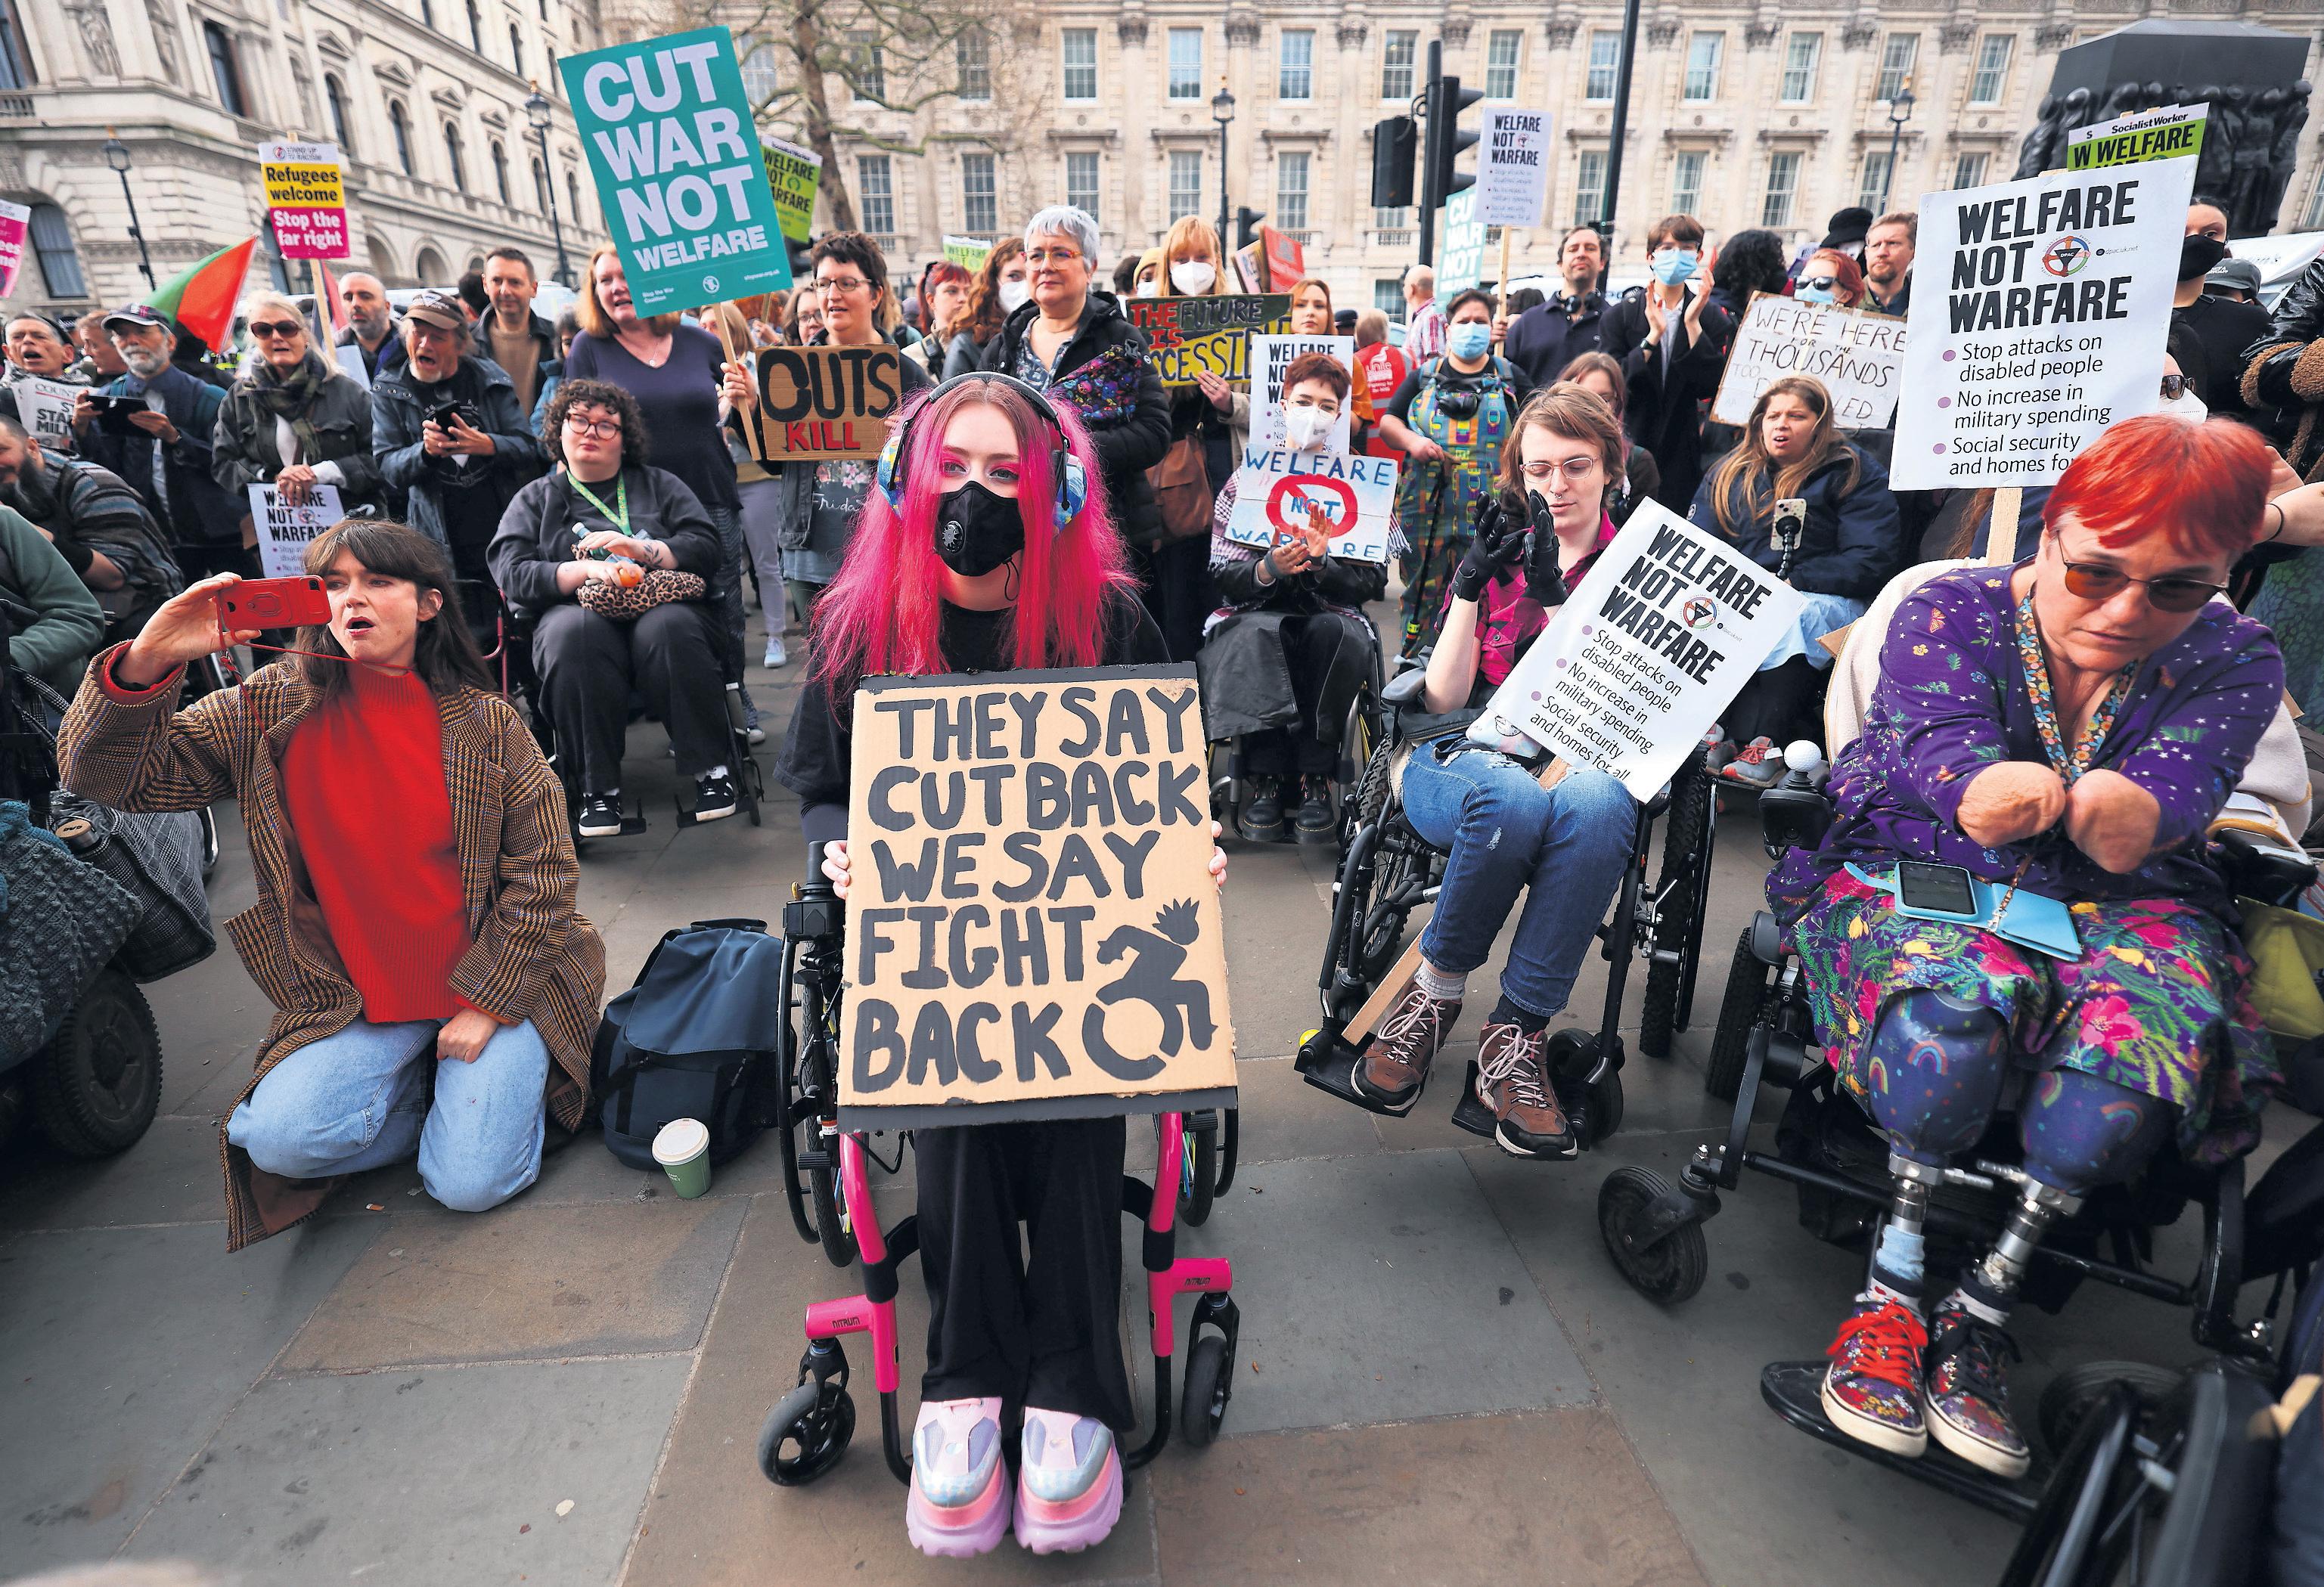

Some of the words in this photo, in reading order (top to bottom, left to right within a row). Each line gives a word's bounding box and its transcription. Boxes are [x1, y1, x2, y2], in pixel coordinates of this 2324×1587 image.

[583, 41, 718, 122] CUT
[1493, 132, 1516, 147] NOT
[1495, 115, 1541, 132] WELFARE
[2111, 119, 2152, 134] Socialist
[2154, 113, 2188, 126] Worker
[593, 107, 749, 182] WAR
[1491, 149, 1538, 166] WARFARE
[2098, 124, 2195, 163] WELFARE
[266, 167, 338, 186] Refugees
[764, 147, 814, 181] WELFARE
[270, 186, 337, 201] welcome
[616, 164, 754, 243] NOT
[771, 186, 811, 213] ARFARE
[1448, 194, 1475, 225] CU
[274, 210, 310, 231] Stop
[312, 211, 341, 228] the
[1958, 181, 2139, 246] WELFARE
[277, 229, 301, 246] far
[303, 230, 343, 250] right
[633, 225, 768, 272] WELFARE
[1446, 222, 1484, 253] WAR
[1441, 247, 1482, 280] NOT
[1951, 240, 2034, 290] NOT
[1130, 302, 1179, 329] THE
[1180, 297, 1264, 329] FUTURE
[1948, 276, 2133, 334] WARFARE
[1150, 328, 1185, 349] IS
[1756, 306, 1827, 336] WE'RE
[1842, 321, 1907, 352] HERE
[1791, 338, 1817, 348] FOR
[1835, 345, 1851, 355] THE
[1963, 343, 2003, 361] Stop
[2008, 334, 2073, 356] attacks
[2079, 336, 2102, 351] on
[1268, 364, 1287, 383] NO
[1749, 339, 1894, 388] THOUSANDS
[1960, 359, 2036, 383] disabled
[2041, 355, 2103, 380] people
[759, 346, 898, 422] CUTS
[1957, 390, 1981, 408] No
[1987, 389, 2061, 406] increase
[2067, 383, 2083, 401] in
[1955, 411, 2022, 429] military
[2028, 404, 2112, 428] spending
[784, 420, 861, 453] KILL
[1953, 434, 2004, 454] Social
[2009, 432, 2080, 452] security
[1246, 448, 1392, 486] WELFARE
[1950, 457, 1981, 475] and
[1987, 457, 2045, 473] homes
[264, 491, 326, 507] WERE
[1291, 496, 1341, 519] NOT
[267, 508, 293, 524] NOT
[1231, 528, 1382, 559] WARRE
[1621, 556, 1689, 609] NOT
[1642, 524, 1772, 620] WELFARE
[1599, 585, 1725, 685] WARFARE
[1582, 647, 1635, 684] disabled
[1629, 680, 1671, 712] people
[1593, 630, 1621, 656] Stop
[1620, 652, 1665, 683] attacks
[1665, 681, 1681, 696] on
[1568, 662, 1586, 681] No
[1587, 675, 1634, 715] increase
[1634, 708, 1647, 724] in
[874, 690, 1048, 761] THEY
[1059, 687, 1196, 757] SAY
[1543, 696, 1581, 727] Social
[1578, 724, 1624, 759] security
[1556, 681, 1602, 715] military
[1600, 711, 1654, 754] spending
[1531, 714, 1557, 733] and
[1553, 726, 1593, 760] homes
[1593, 755, 1612, 773] for
[1613, 770, 1631, 780] all
[867, 764, 1016, 832] CUT
[1025, 760, 1204, 831] BACK
[870, 832, 986, 903] WE
[991, 830, 1161, 903] SAY
[858, 904, 1095, 990] FIGHT
[852, 998, 1072, 1094] BACK
